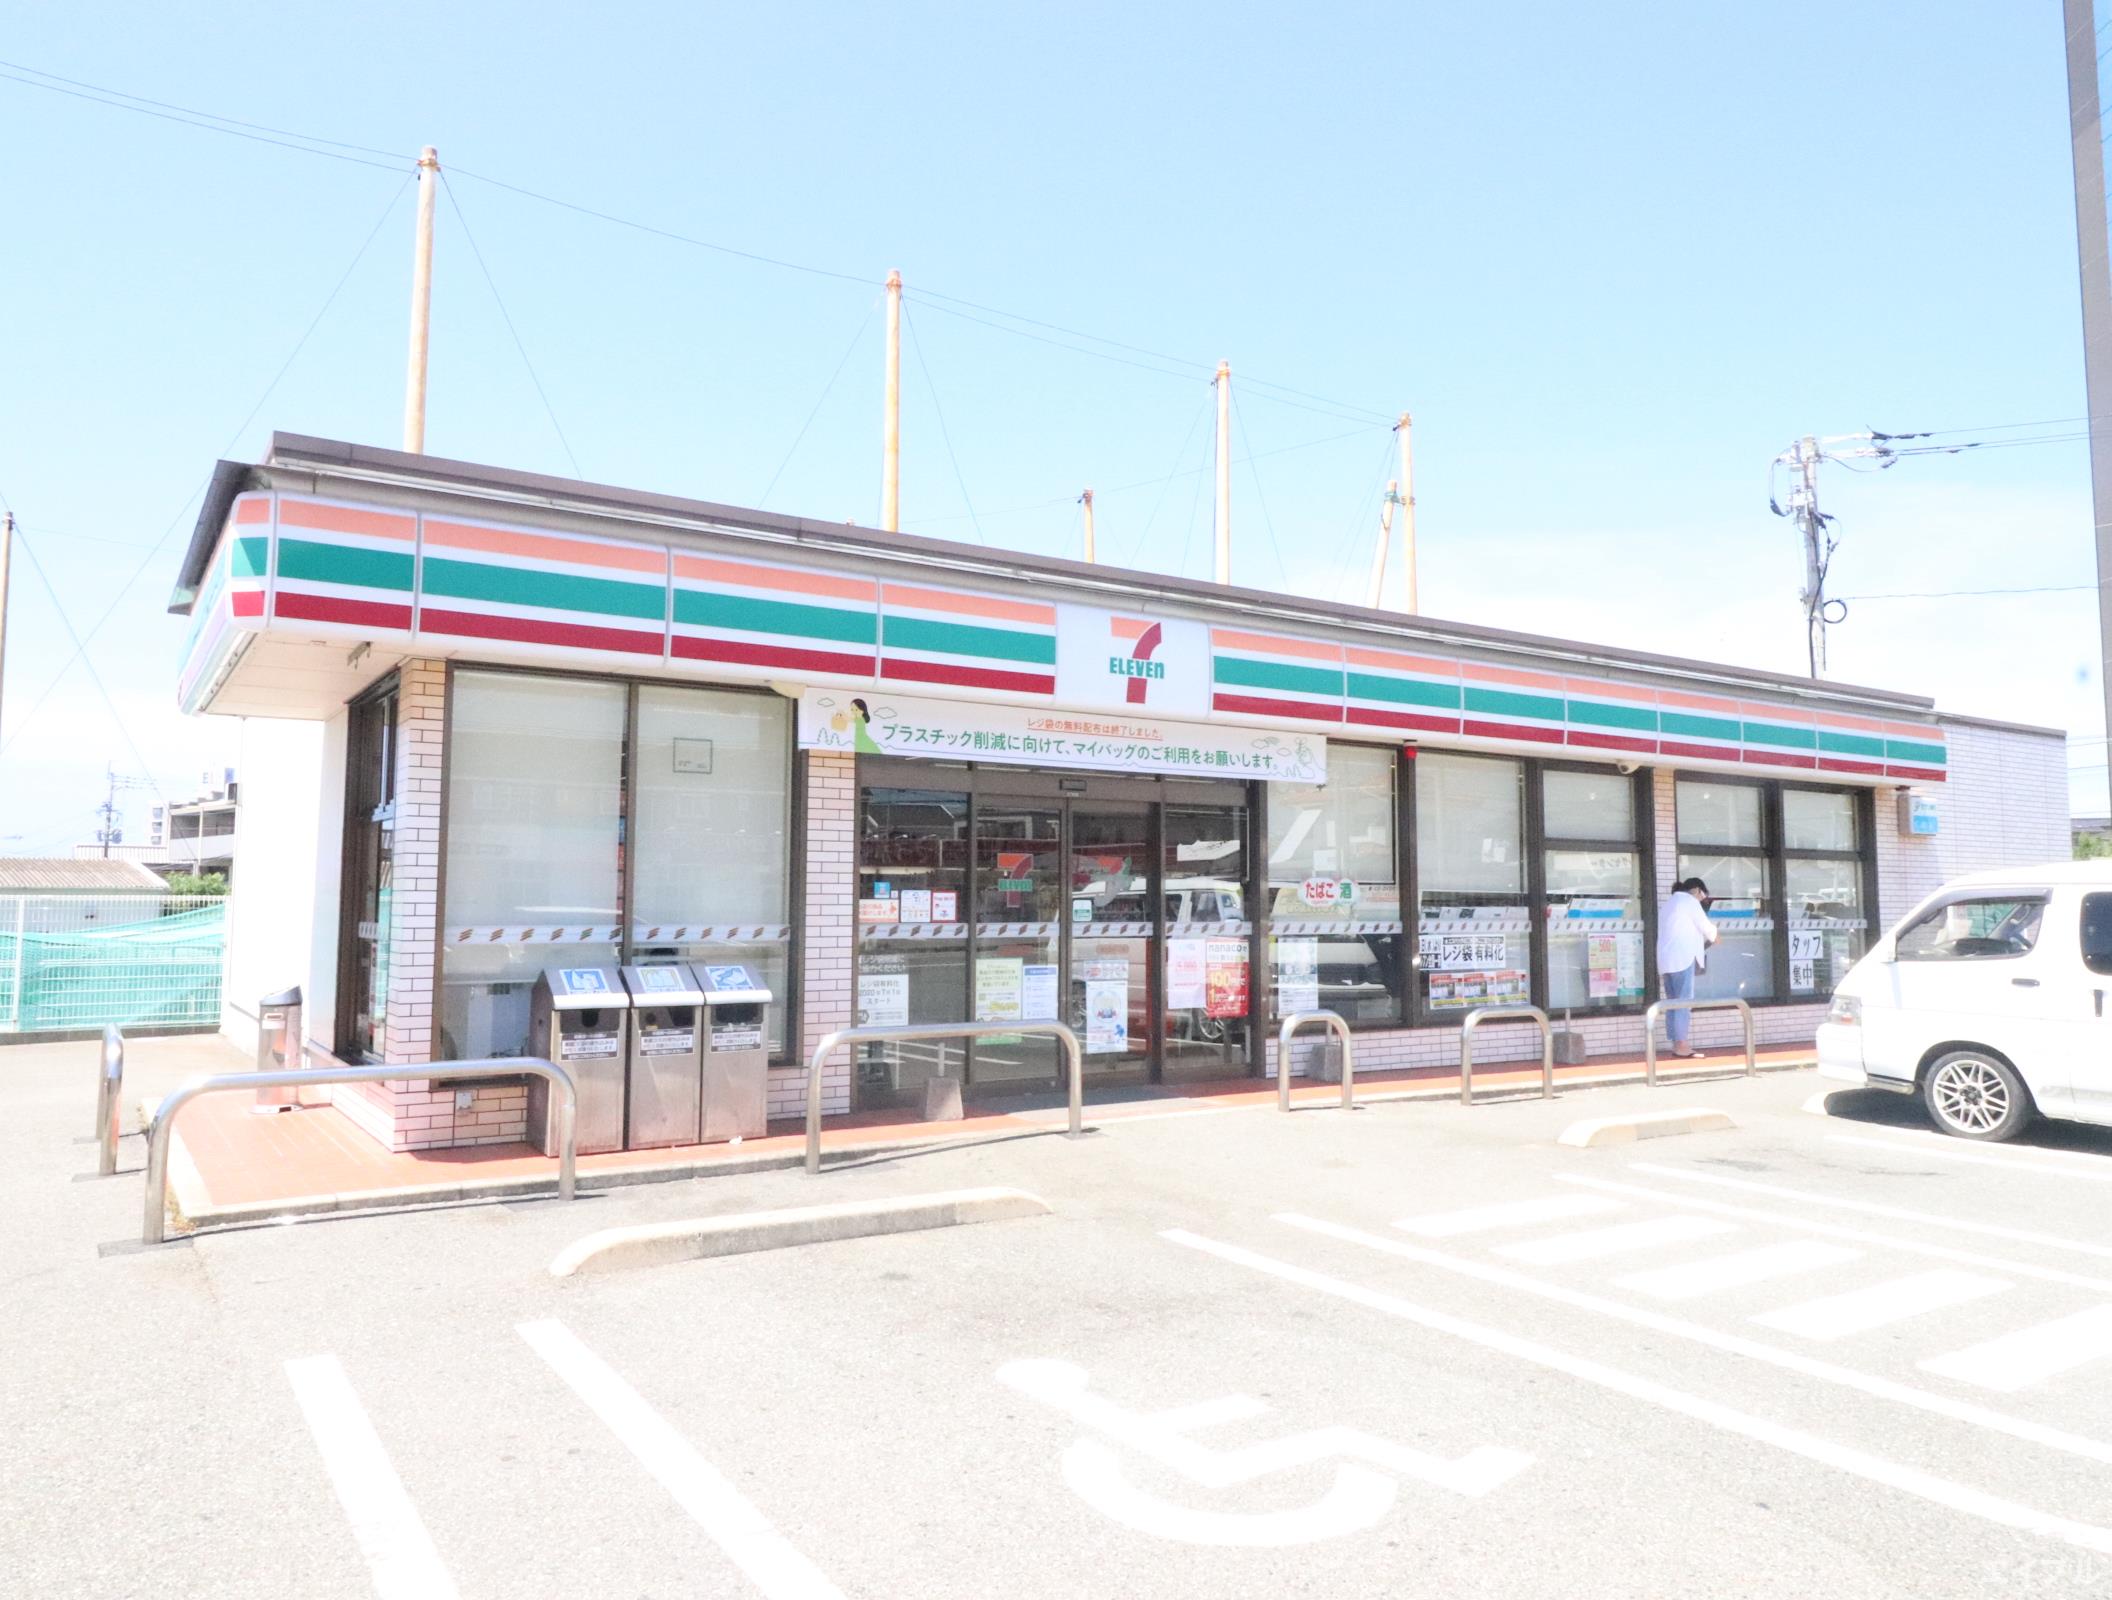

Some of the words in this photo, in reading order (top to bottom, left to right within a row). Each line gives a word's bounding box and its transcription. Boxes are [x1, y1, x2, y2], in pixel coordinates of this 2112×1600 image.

[1026, 717, 1164, 739] レジ袋の無料配布は終了しました。
[882, 723, 1279, 769] プラスチック削減に向けて、マイバッグのご利用をお願いします。
[1305, 882, 1335, 899] たばこ
[1339, 882, 1352, 899] 酒
